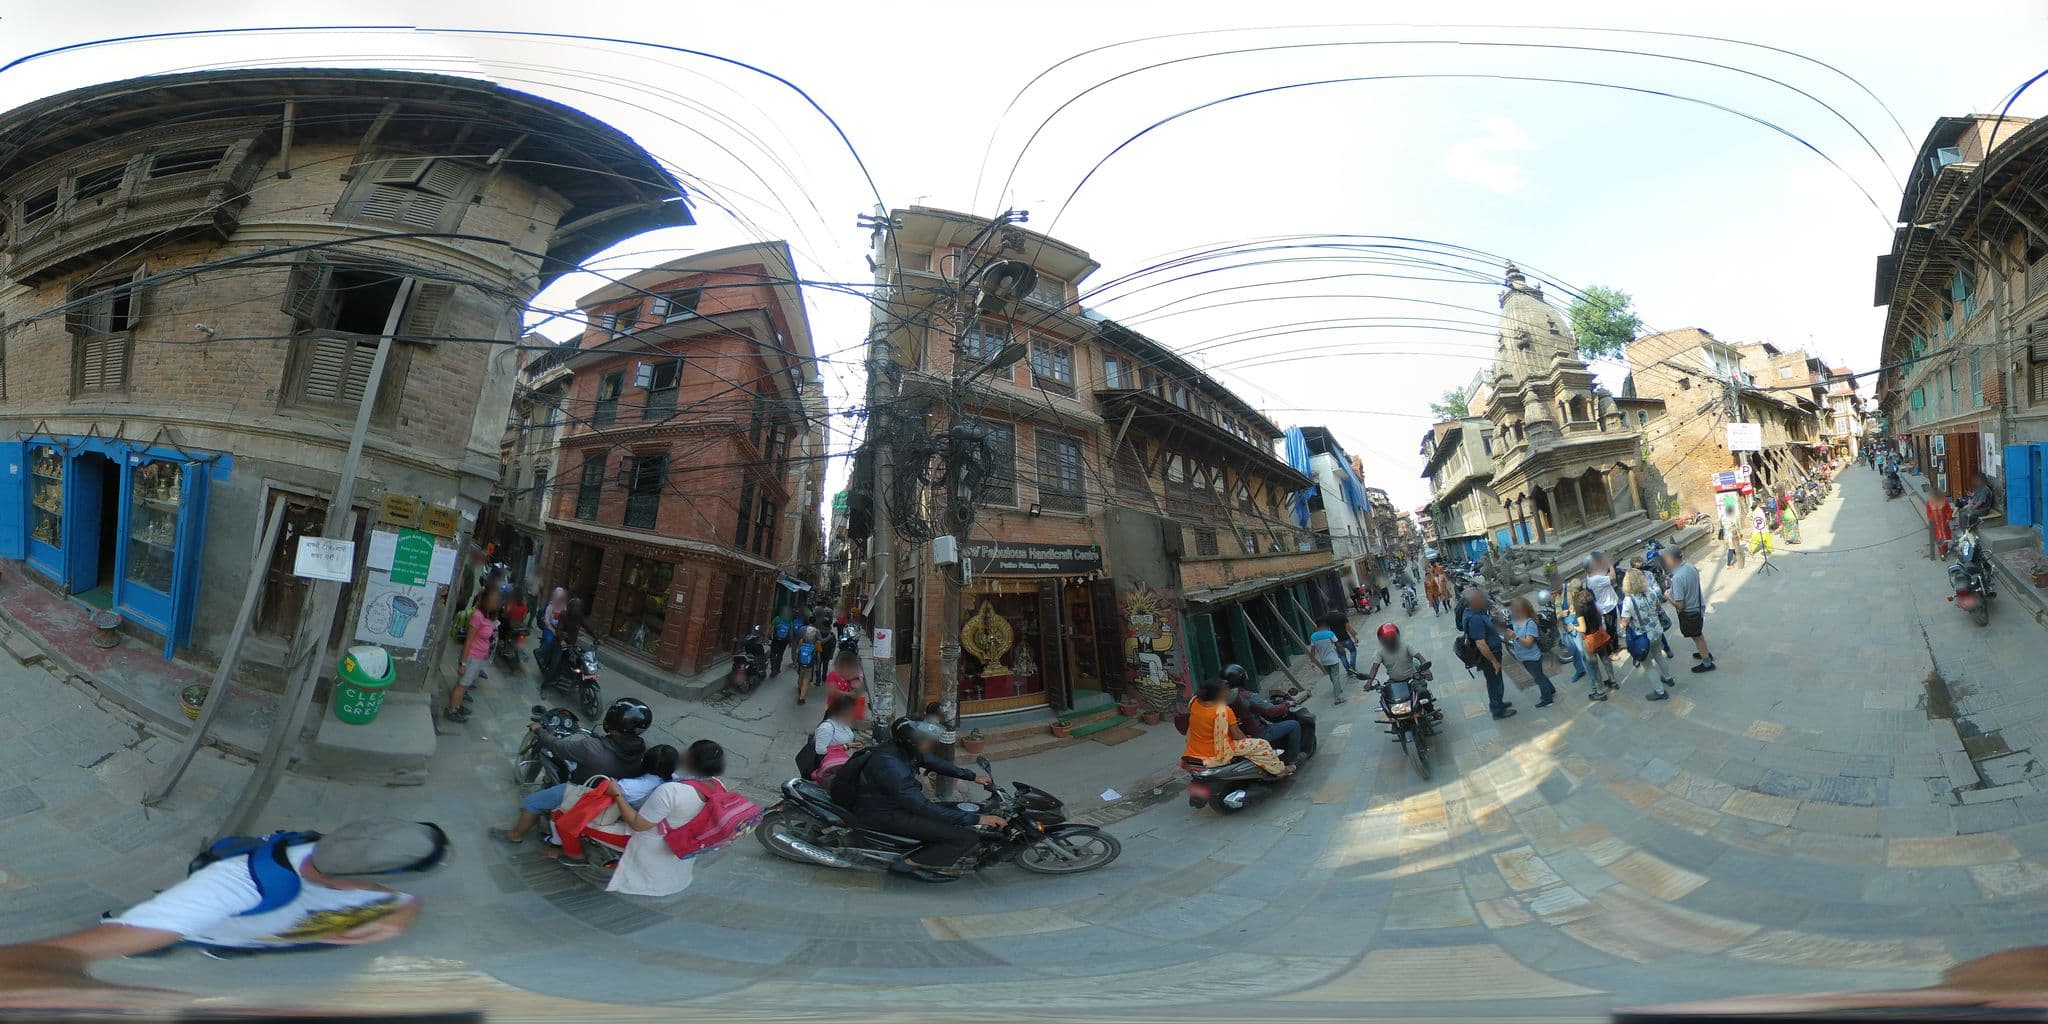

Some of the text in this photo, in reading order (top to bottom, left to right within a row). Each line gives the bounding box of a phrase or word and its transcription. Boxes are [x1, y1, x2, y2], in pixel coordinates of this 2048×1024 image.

[981, 546, 1028, 559] Fabulous
[1029, 547, 1073, 560] Handicraft
[346, 689, 385, 701] CLEA
[343, 704, 378, 716] GREE
